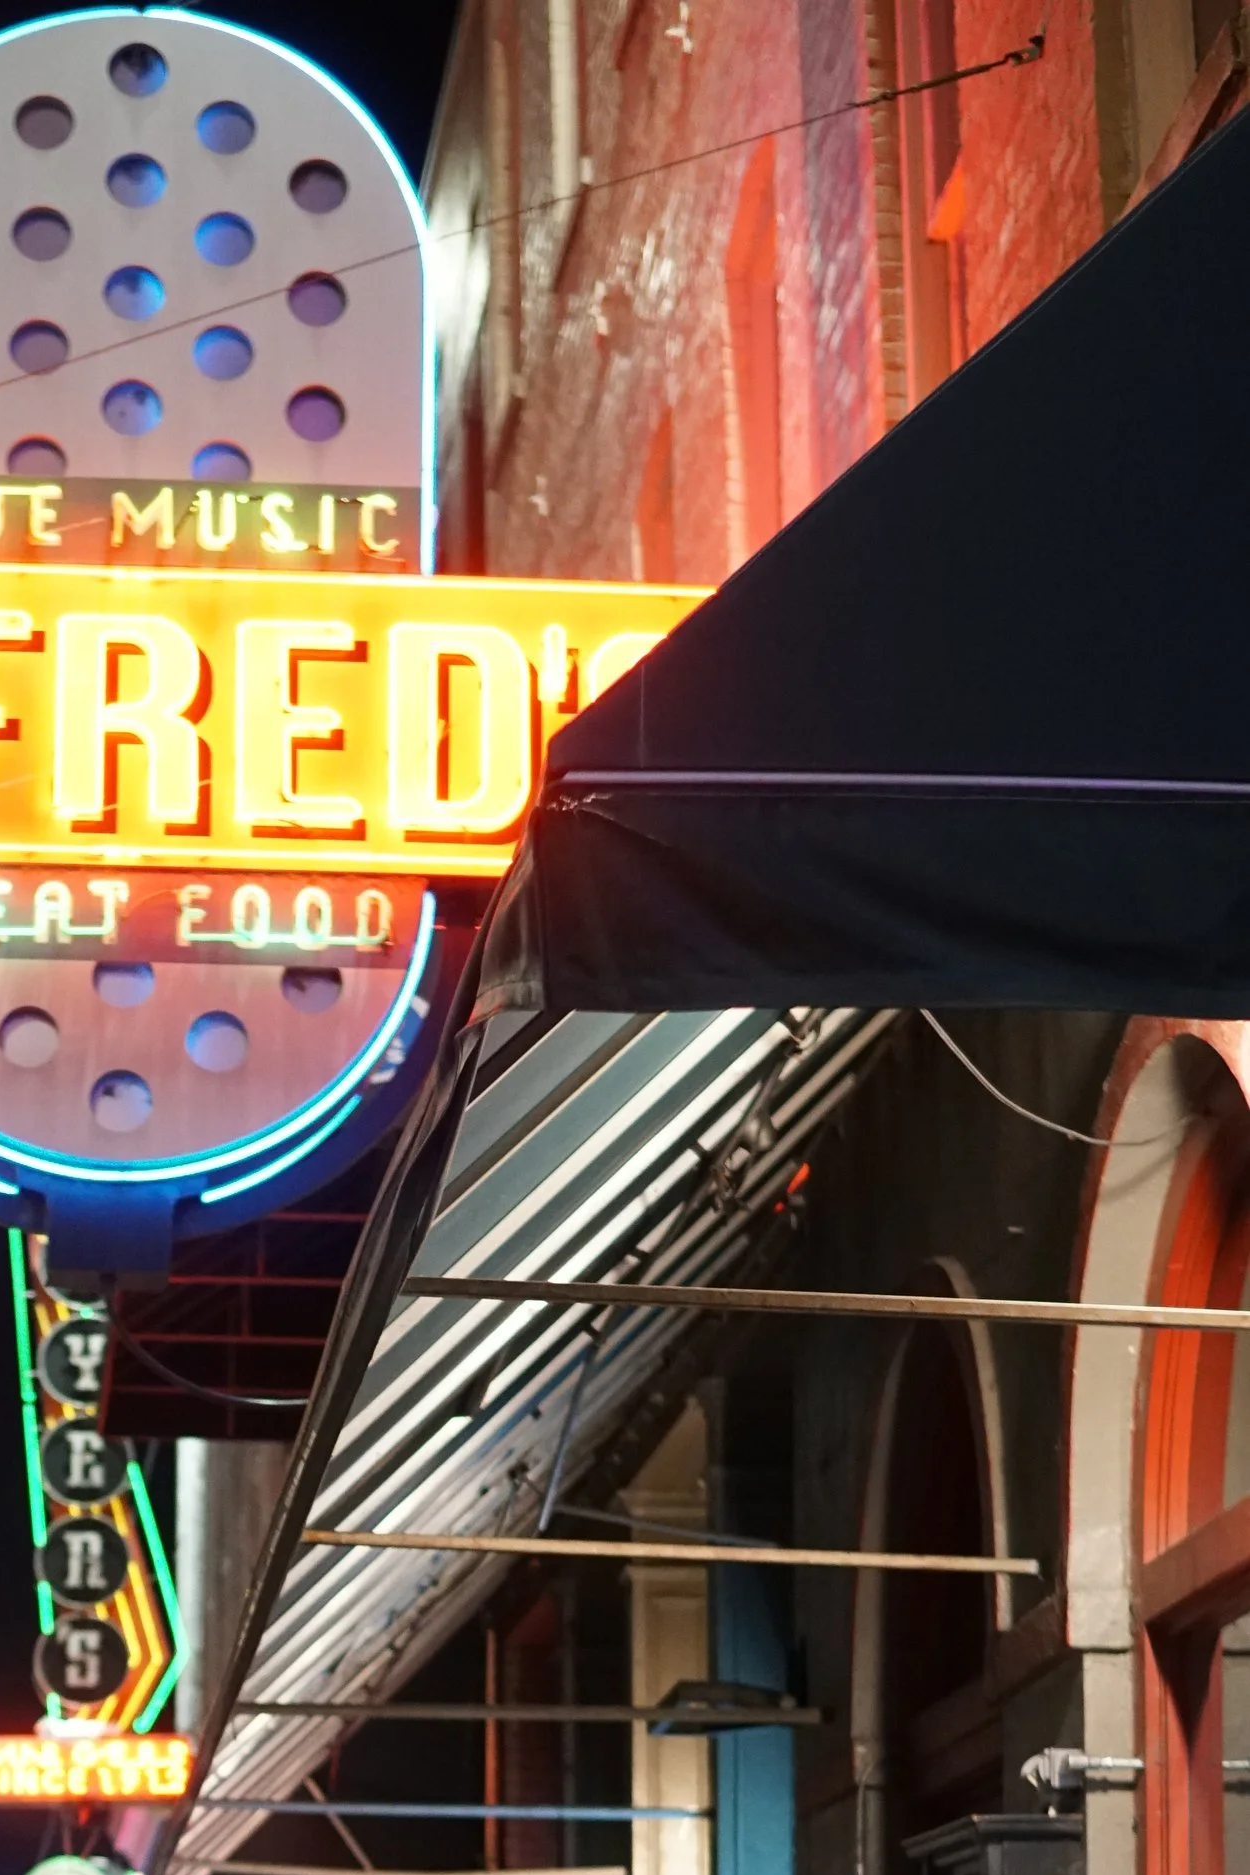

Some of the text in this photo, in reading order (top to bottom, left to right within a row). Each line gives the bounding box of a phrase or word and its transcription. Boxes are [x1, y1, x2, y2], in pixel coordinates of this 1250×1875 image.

[110, 486, 399, 554] MUSIC
[177, 883, 394, 951] FOOD
[58, 1332, 108, 1690] YER'S
